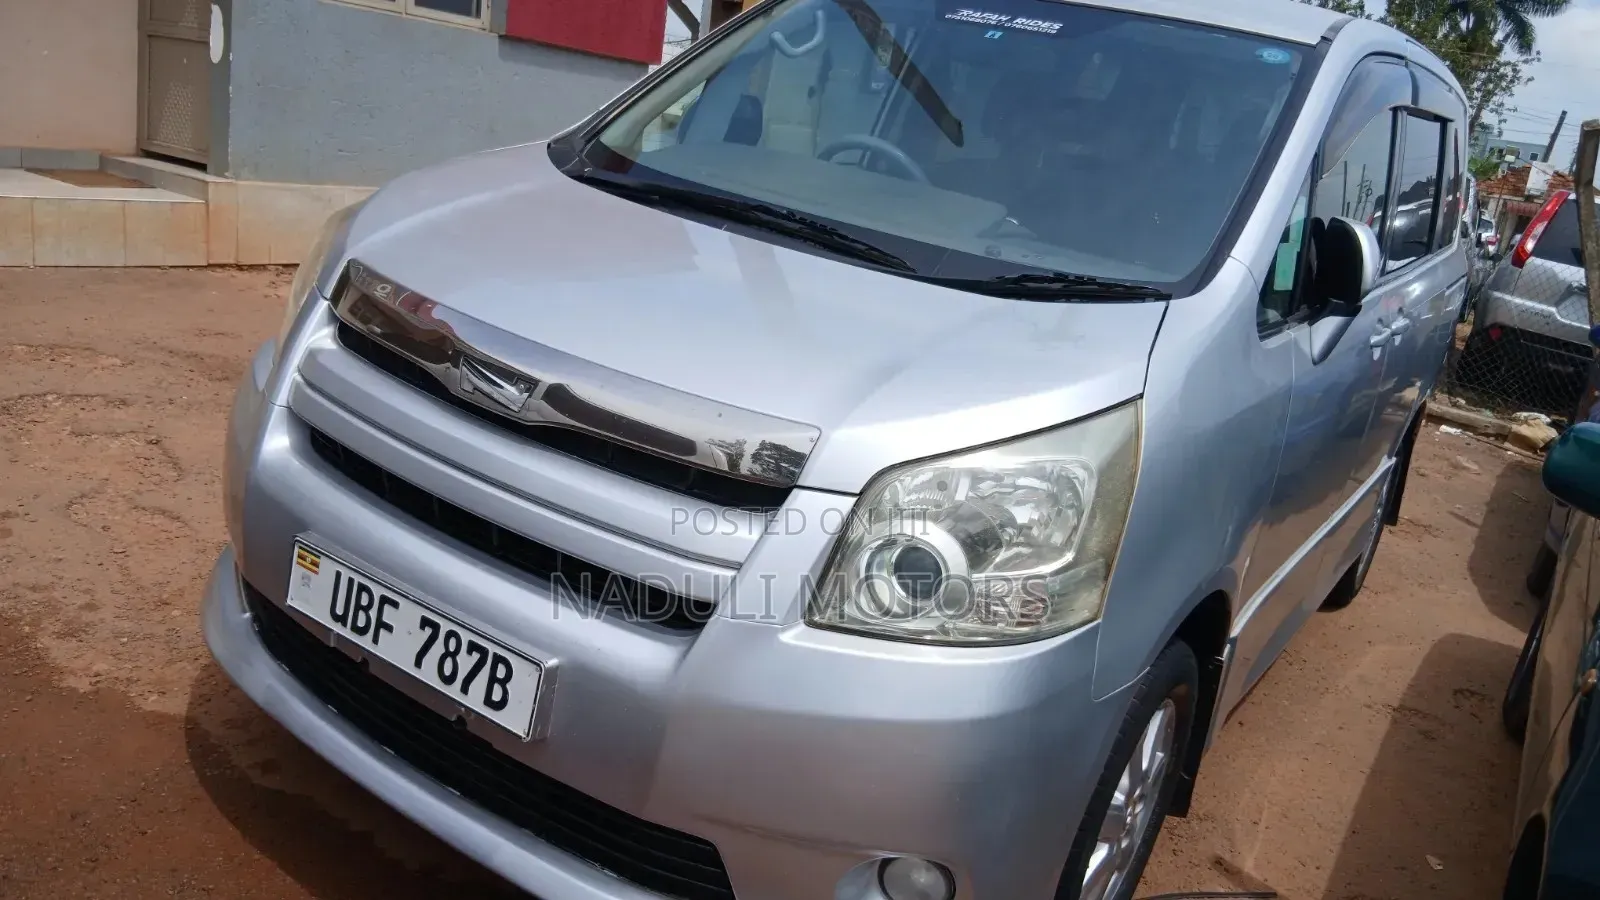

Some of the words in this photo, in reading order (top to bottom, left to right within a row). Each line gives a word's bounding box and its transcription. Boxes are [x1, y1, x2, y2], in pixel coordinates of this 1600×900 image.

[955, 8, 1011, 22] RAFAH
[1012, 17, 1064, 30] RIDES
[329, 569, 400, 646] UBF
[413, 614, 514, 712] 787B
